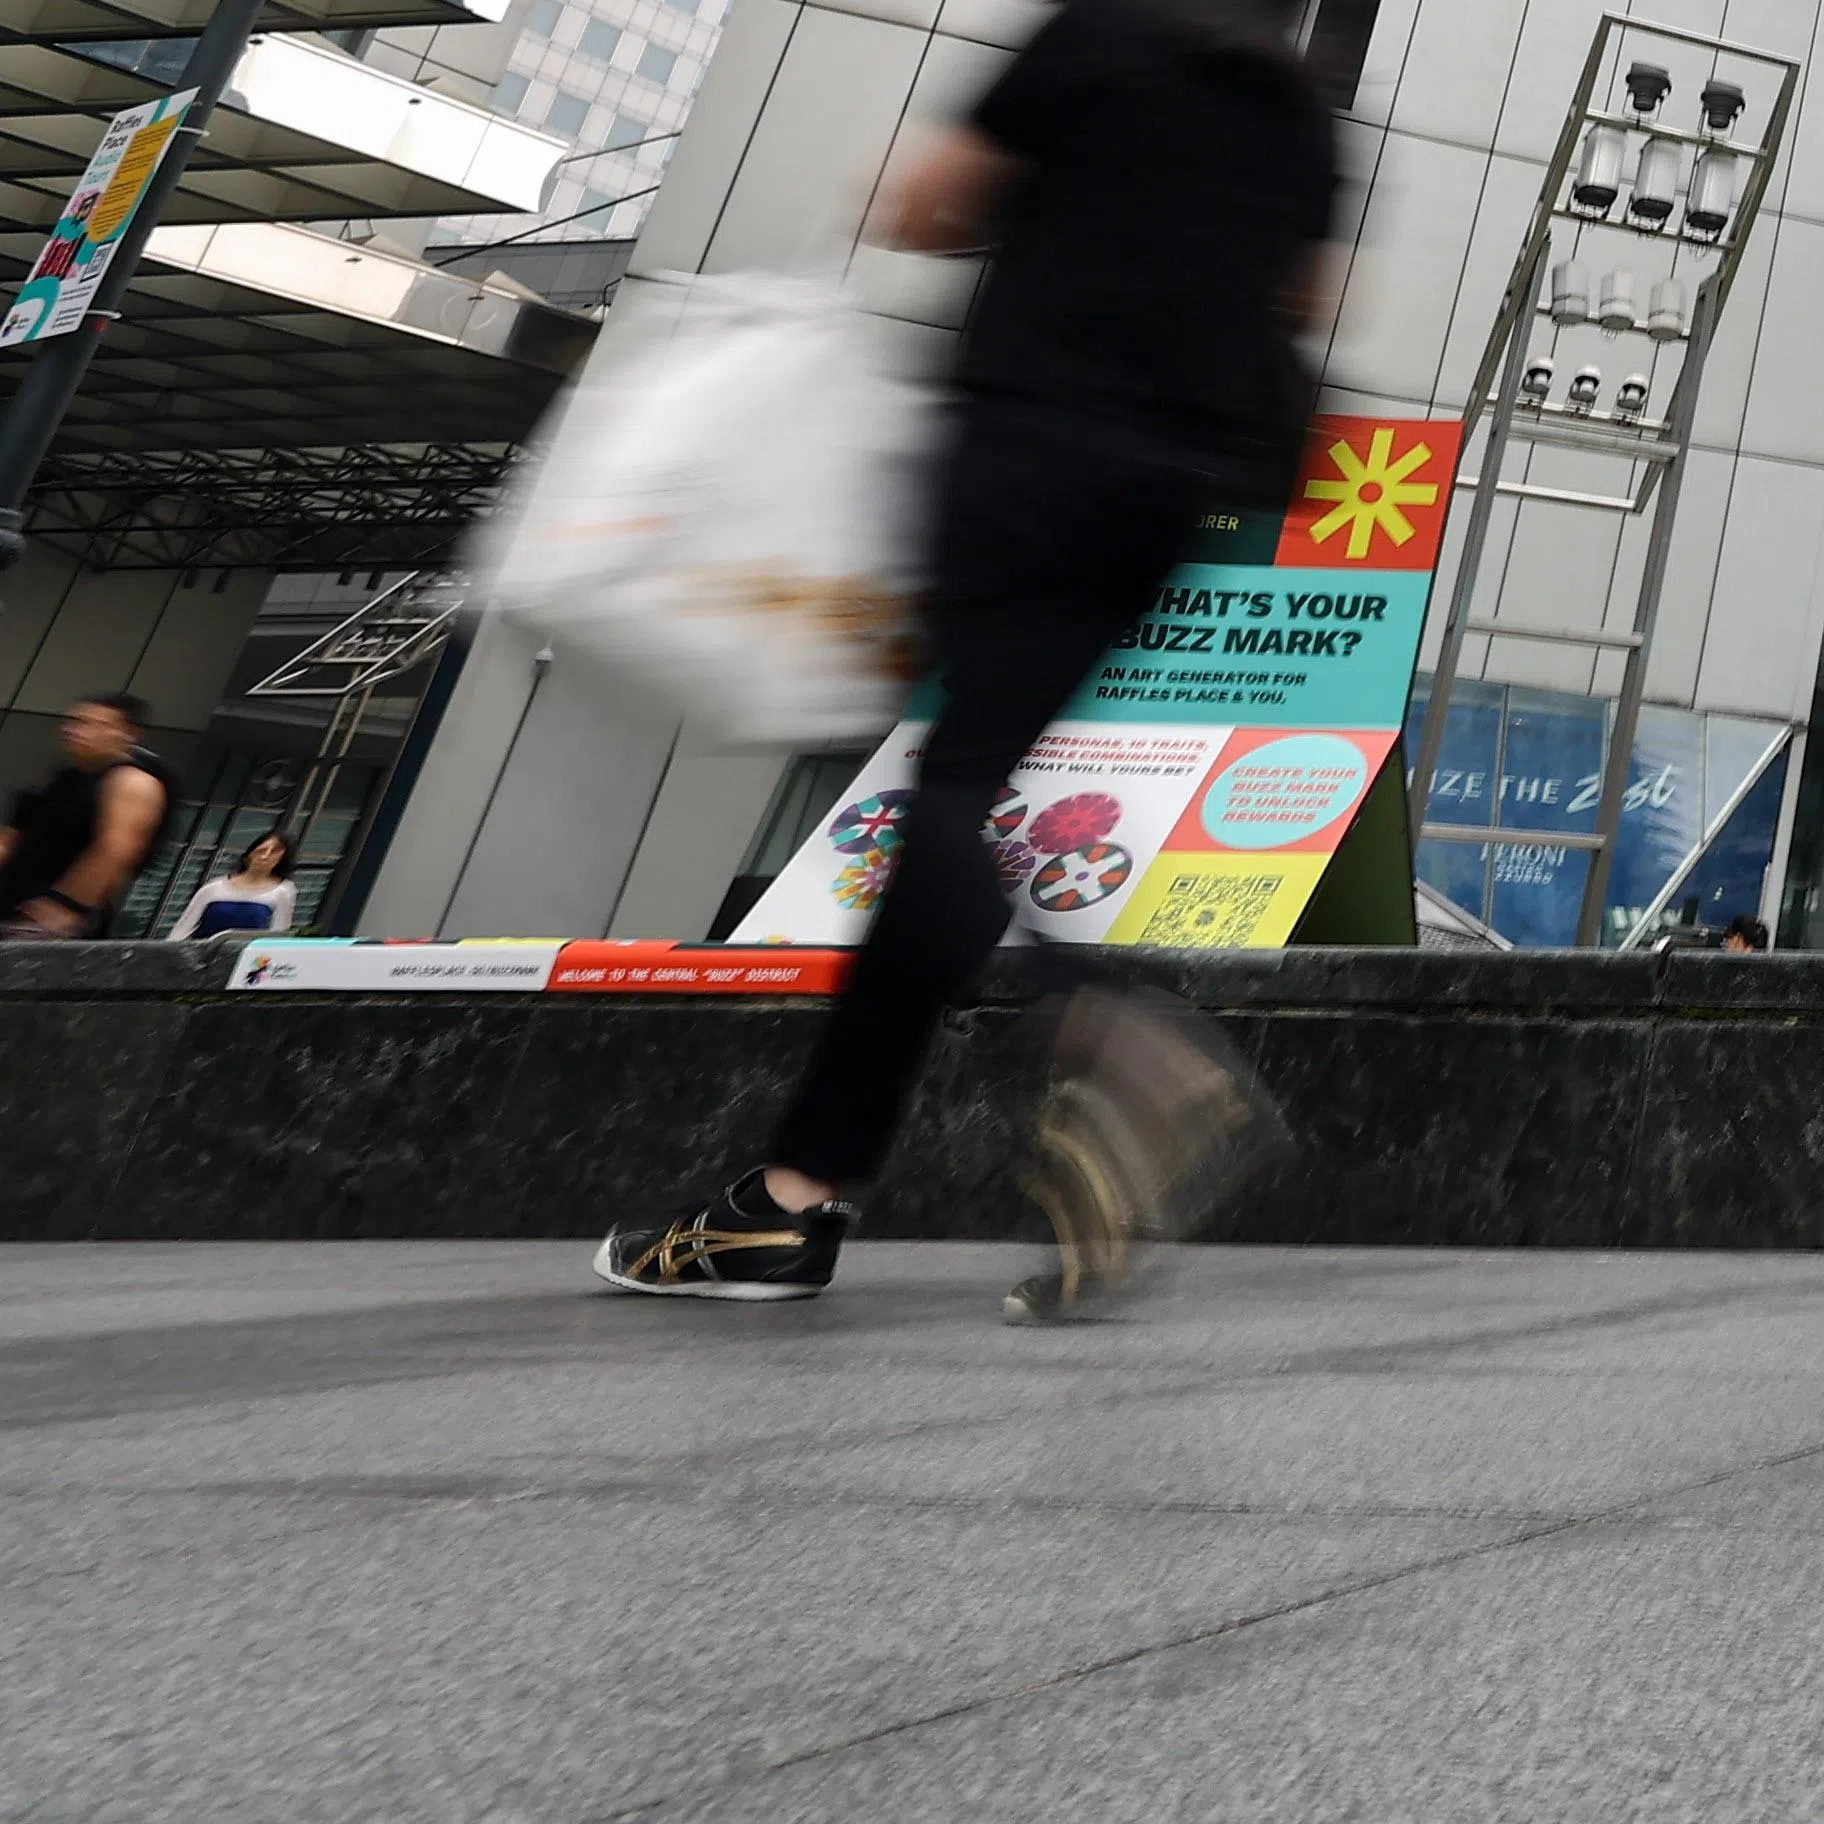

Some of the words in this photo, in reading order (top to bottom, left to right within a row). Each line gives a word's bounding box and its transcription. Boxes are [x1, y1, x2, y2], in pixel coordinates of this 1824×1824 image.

[1286, 593, 1388, 621] YOUR
[1111, 622, 1217, 653] BUZZ
[1223, 629, 1363, 657] MARK?
[1100, 666, 1127, 680] AN
[1129, 668, 1162, 682] ART
[1168, 670, 1268, 686] GENERATOR
[1272, 672, 1307, 688] FOR
[1095, 686, 1170, 702] RAFFLES
[1173, 688, 1229, 704] PLACE
[1232, 690, 1242, 703] &
[1023, 748, 1079, 758] SSIBLE
[1018, 761, 1065, 771] WHAT
[1068, 762, 1104, 773] WILL
[1498, 774, 1562, 804] THE
[1566, 763, 1676, 814] Zst
[557, 967, 606, 983] WELCOME
[608, 967, 625, 983] TO
[627, 967, 650, 983] THE
[651, 967, 699, 983] CENTRAL
[745, 967, 802, 983] DISTRICT
